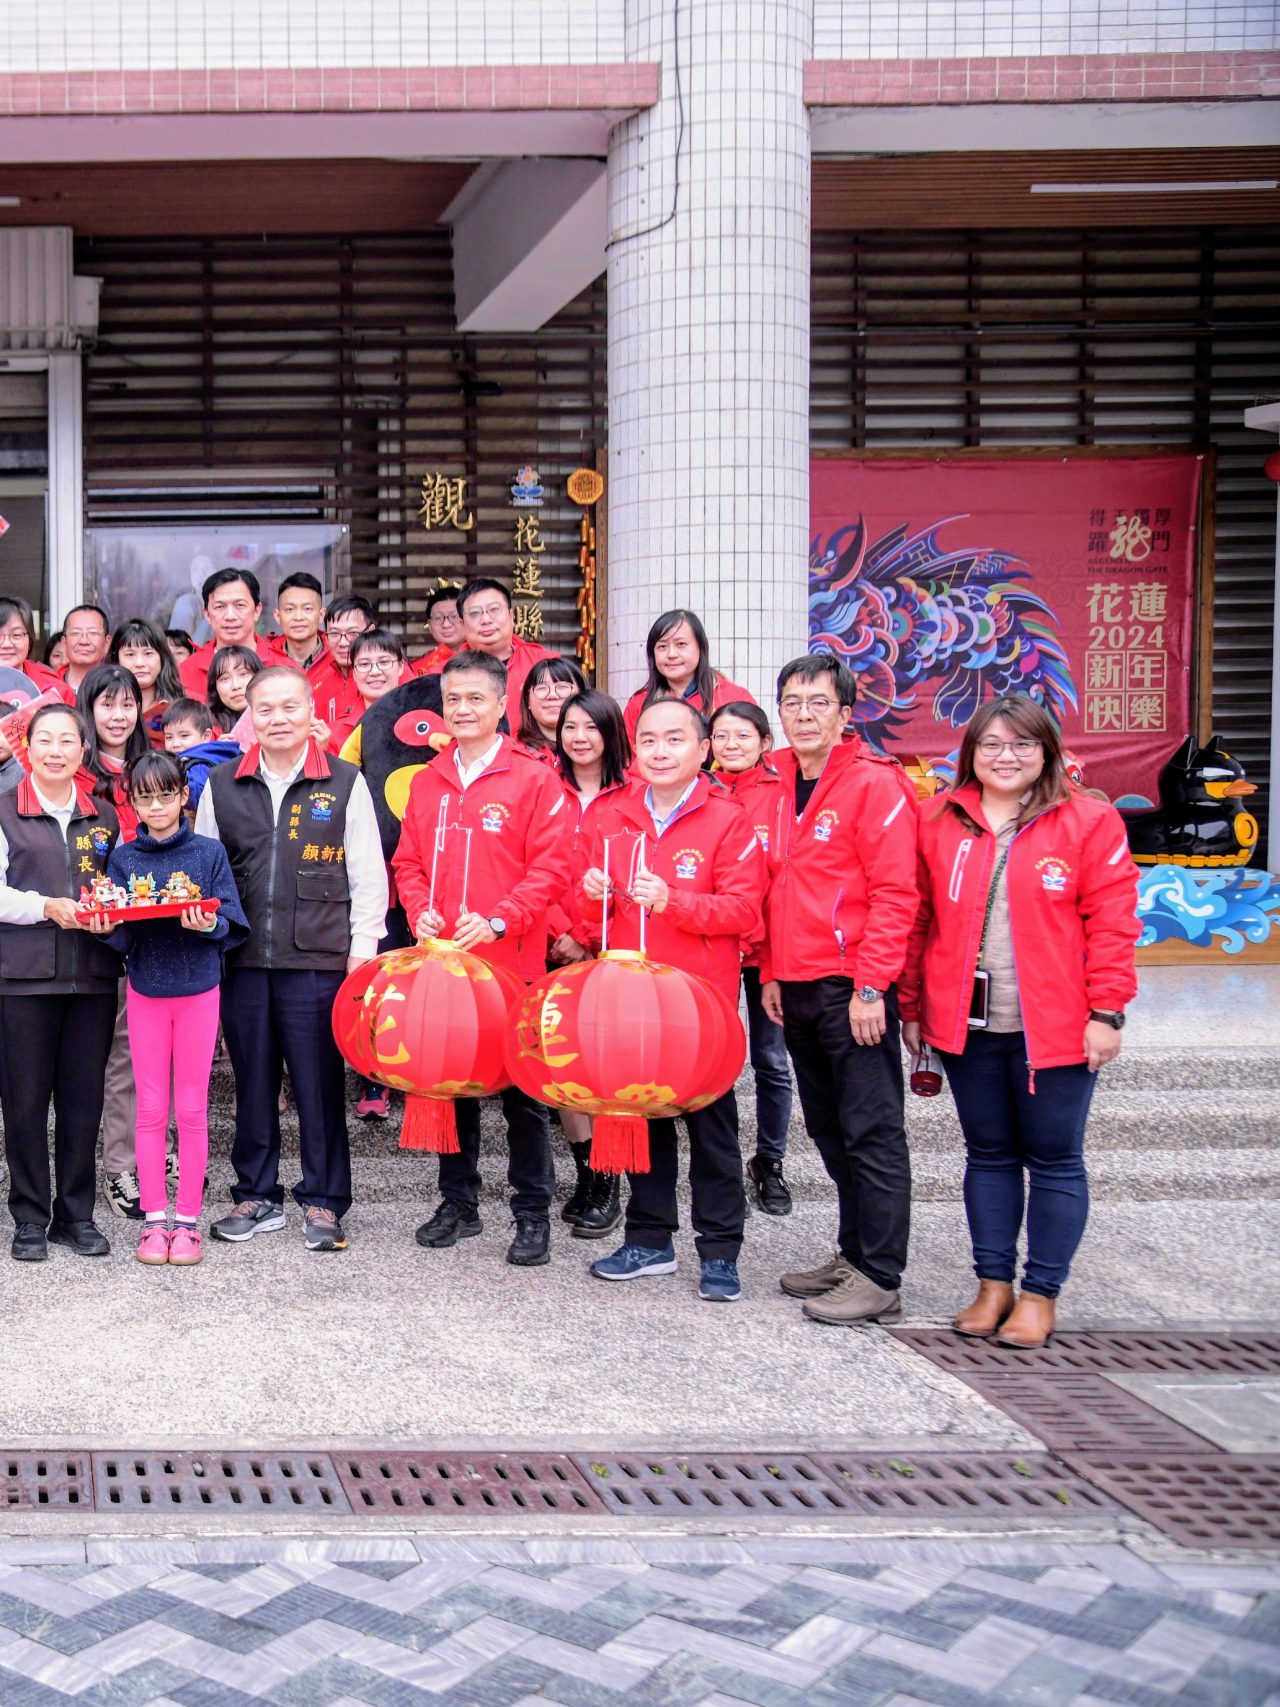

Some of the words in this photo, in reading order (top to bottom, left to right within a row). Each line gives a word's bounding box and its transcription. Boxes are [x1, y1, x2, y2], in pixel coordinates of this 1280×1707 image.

[514, 515, 546, 640] 花蓮縣
[1086, 582, 1168, 623] 花蓮
[1089, 625, 1164, 649] 2024
[1089, 654, 1163, 689] 新年
[1088, 695, 1163, 729] 快樂
[288, 804, 302, 840] 副縣長
[76, 835, 95, 873] 縣長
[346, 983, 411, 1065] 花
[517, 983, 579, 1068] 蓮
